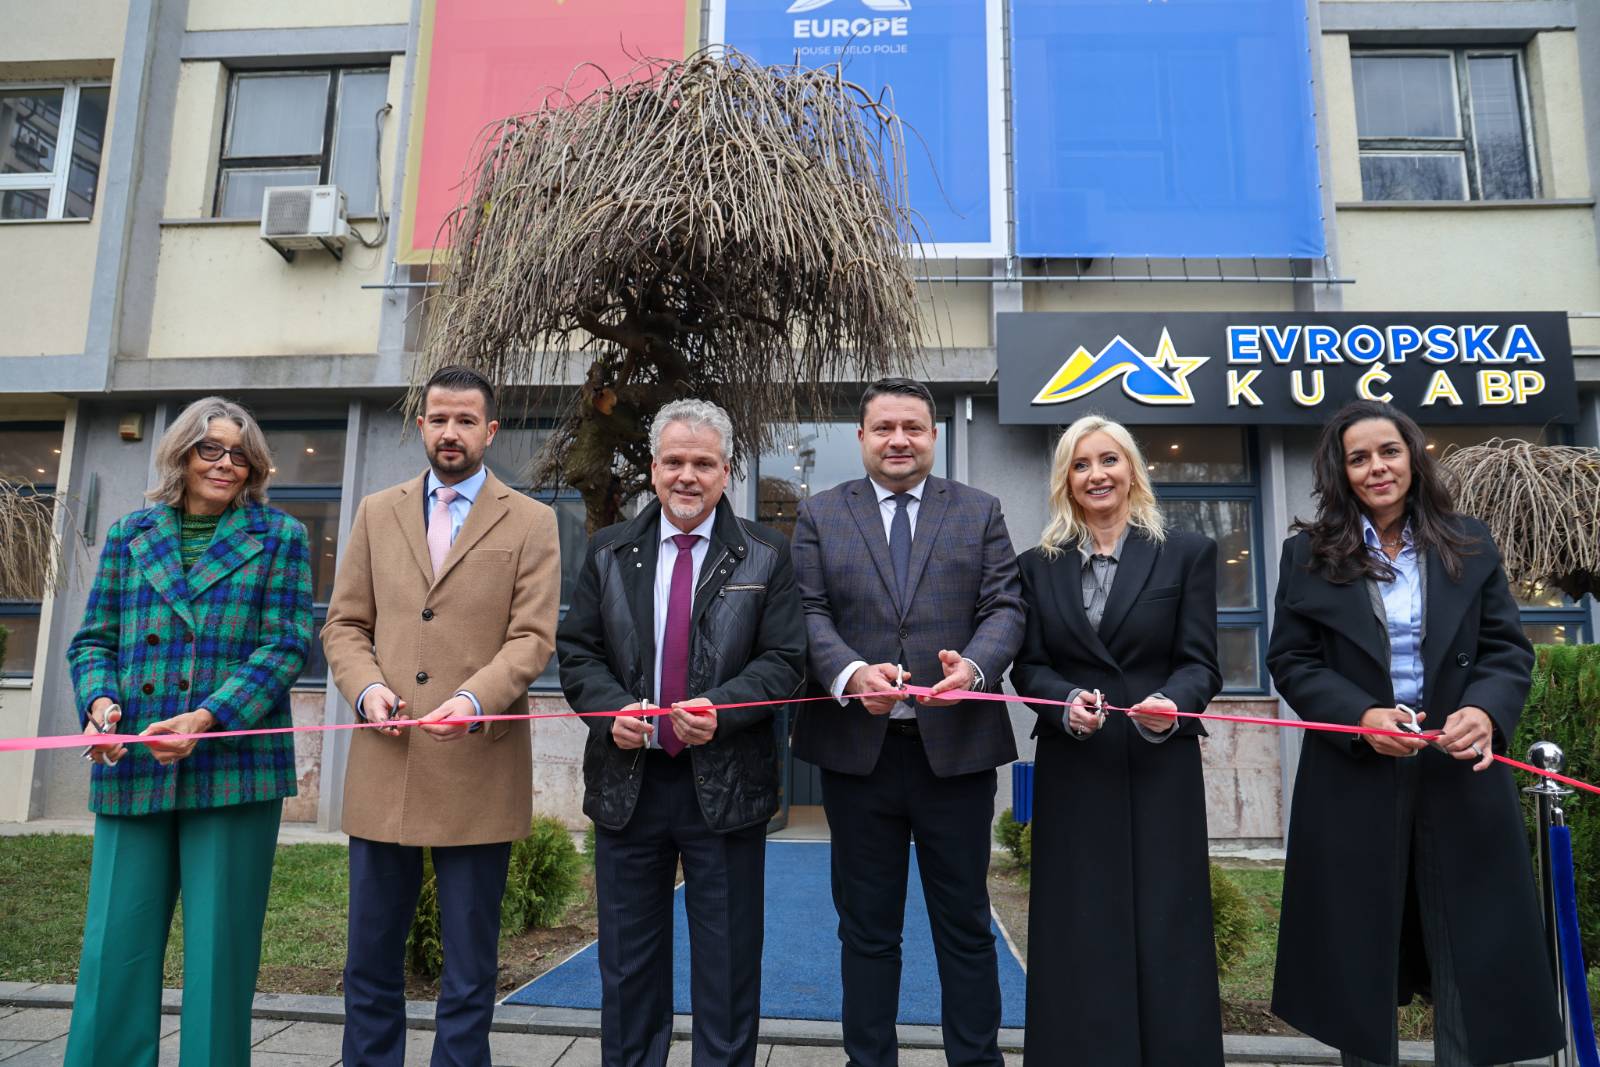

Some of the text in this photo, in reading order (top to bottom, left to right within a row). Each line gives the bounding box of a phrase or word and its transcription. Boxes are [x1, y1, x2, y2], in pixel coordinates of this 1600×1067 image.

[794, 17, 908, 38] EUROPE
[874, 44, 908, 53] POLJE
[1227, 325, 1545, 364] EVROPSKA
[1477, 369, 1546, 406] BP
